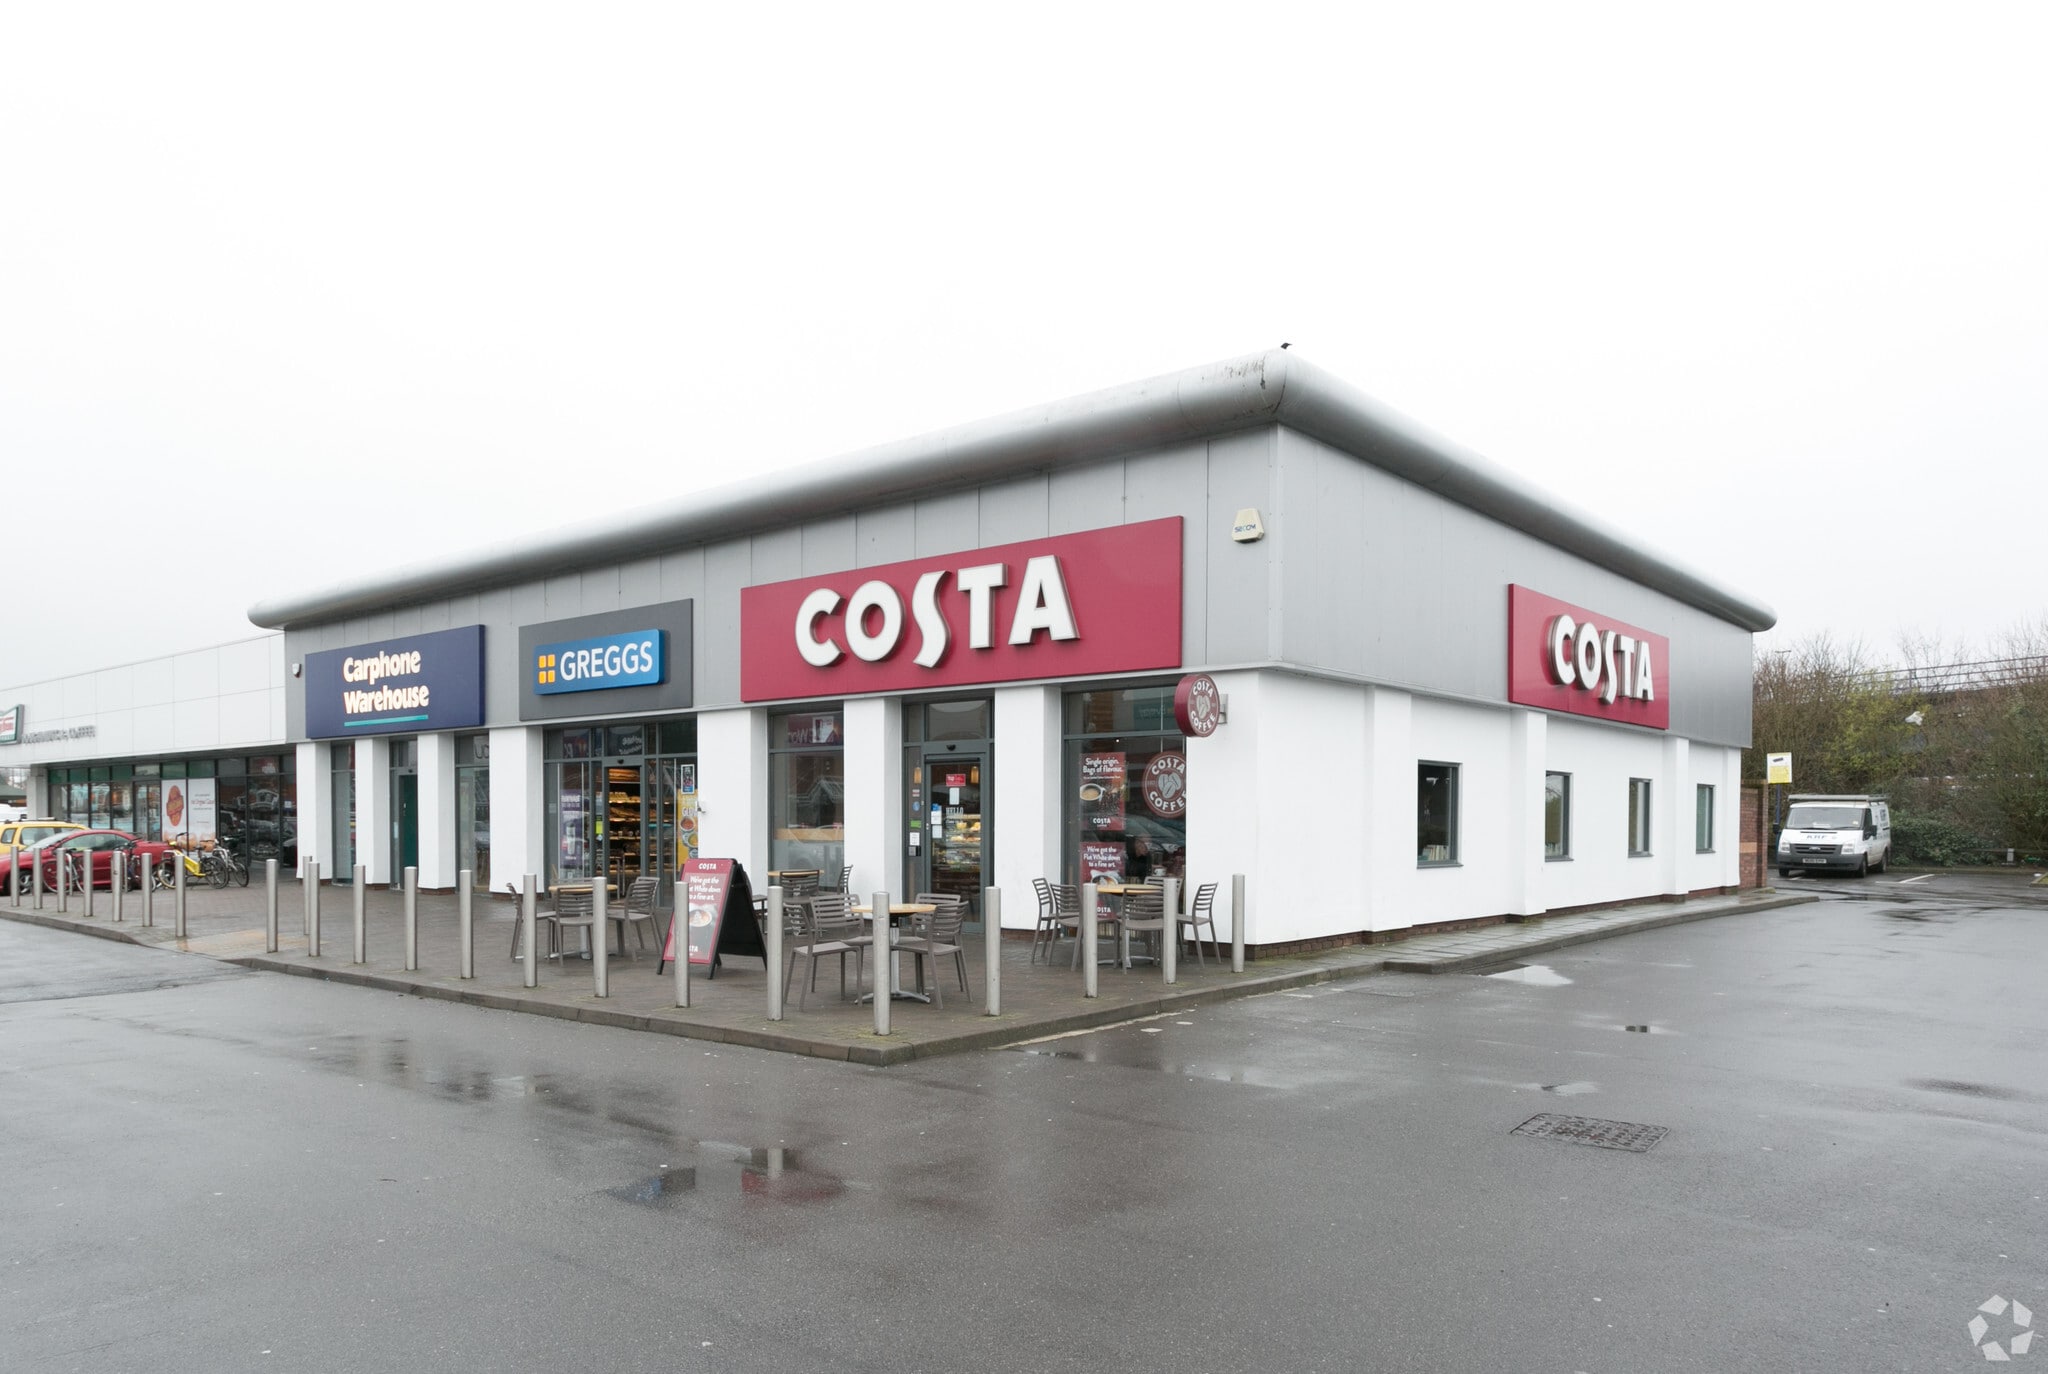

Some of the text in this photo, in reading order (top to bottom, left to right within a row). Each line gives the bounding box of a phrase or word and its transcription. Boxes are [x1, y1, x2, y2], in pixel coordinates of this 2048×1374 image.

[795, 554, 1082, 669] COSTA
[343, 650, 421, 685] Carphone
[560, 640, 653, 681] GREGGS
[1549, 613, 1655, 705] COSTA
[1192, 681, 1214, 698] COSTA
[343, 685, 430, 714] Warehouse
[1190, 710, 1216, 732] COFFEE
[1082, 765, 1096, 776] Bags
[1096, 765, 1102, 773] of
[1085, 757, 1101, 768] Single
[1151, 757, 1186, 776] COSTA
[1092, 817, 1111, 825] COSTA
[711, 876, 719, 884] the
[689, 945, 698, 953] STA
